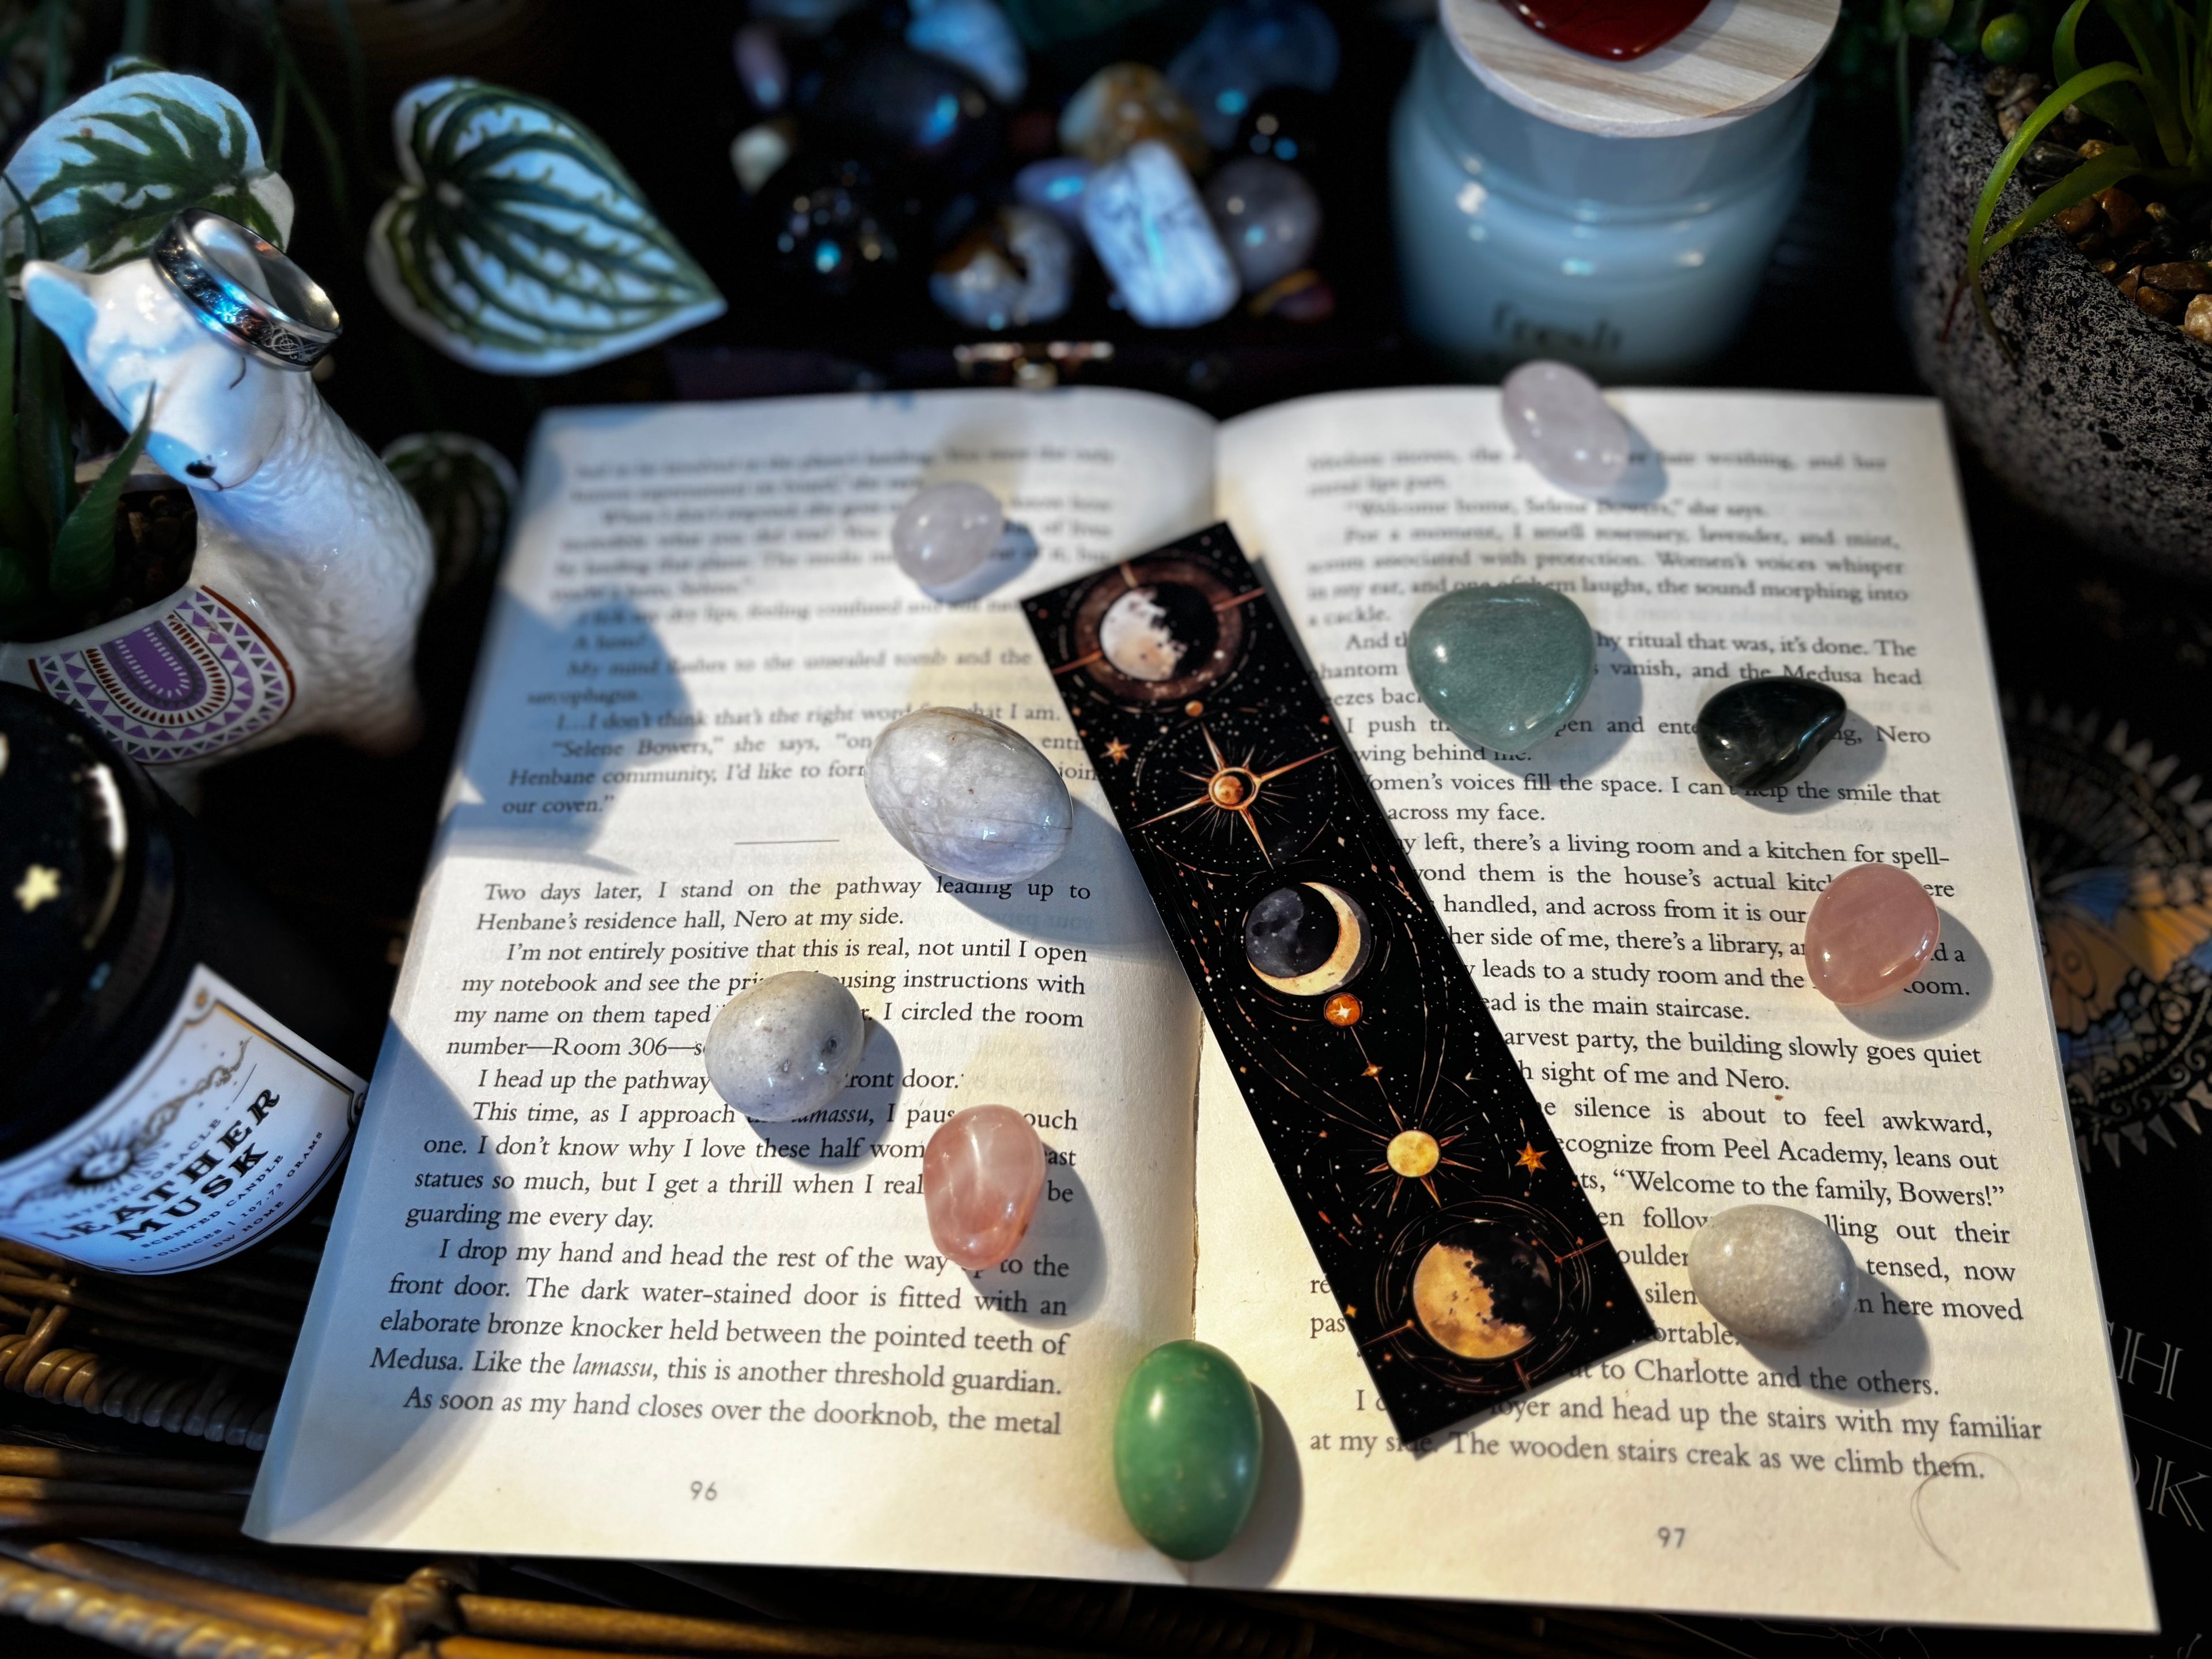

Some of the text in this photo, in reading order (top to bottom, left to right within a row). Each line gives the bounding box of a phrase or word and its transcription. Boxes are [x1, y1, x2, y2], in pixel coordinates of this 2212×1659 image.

[502, 801, 537, 814] our
[1388, 802, 1544, 825] across my face.
[1425, 832, 1949, 869] left, there’s a living room and a kitchen for spell-
[486, 884, 525, 900] Two
[541, 883, 580, 904] days
[594, 882, 641, 901] later,
[658, 882, 666, 897] I
[681, 880, 733, 897] stand
[748, 885, 773, 896] on
[790, 878, 821, 895] the
[835, 876, 922, 900] pathway
[1028, 884, 1054, 902] up
[1070, 885, 1090, 899] to
[1444, 894, 1806, 923] handled, and across from it is our
[476, 906, 903, 931] Henbane’s residence hall, Nero at my side.
[507, 937, 1087, 965] I’m not entirely positive that this is real, not until I open
[1525, 993, 1749, 1019] is the main staircase.
[1577, 1030, 1982, 1068] party, the building slowly goes quiet
[1541, 1062, 1789, 1089] sight of me and Nero.
[1574, 1097, 1992, 1138] silence is about to feel awkward,
[31, 1089, 281, 1241] LEATHER
[150, 1118, 222, 1180] ORACLE
[1661, 1135, 1998, 1170] from Peel Academy, leans out
[111, 1142, 269, 1241] MUSK
[141, 1155, 284, 1248] SCENTED CANDLE
[157, 1229, 222, 1256] OUNCES
[241, 1183, 283, 1218] 107.73
[286, 1130, 323, 1177] GRAMS
[1613, 1169, 2004, 1207] “Welcome to the family, Bowers!”
[212, 1200, 285, 1248] DW HOME
[405, 1203, 653, 1234] guarding me every day.
[388, 1272, 1067, 1316] front door. The dark water-stained door is fitted with an
[1881, 1292, 2024, 1320] here moved
[369, 1347, 1061, 1395] Medusa. Like the lamassu, this is another threshold guardian.
[1601, 1358, 1938, 1395] to Charlotte and the others.
[1560, 1396, 2041, 1442] and head up the stairs with my familiar
[690, 1480, 717, 1501] 96
[2132, 1453, 2211, 1532] K
[1657, 1527, 1686, 1548] 97
